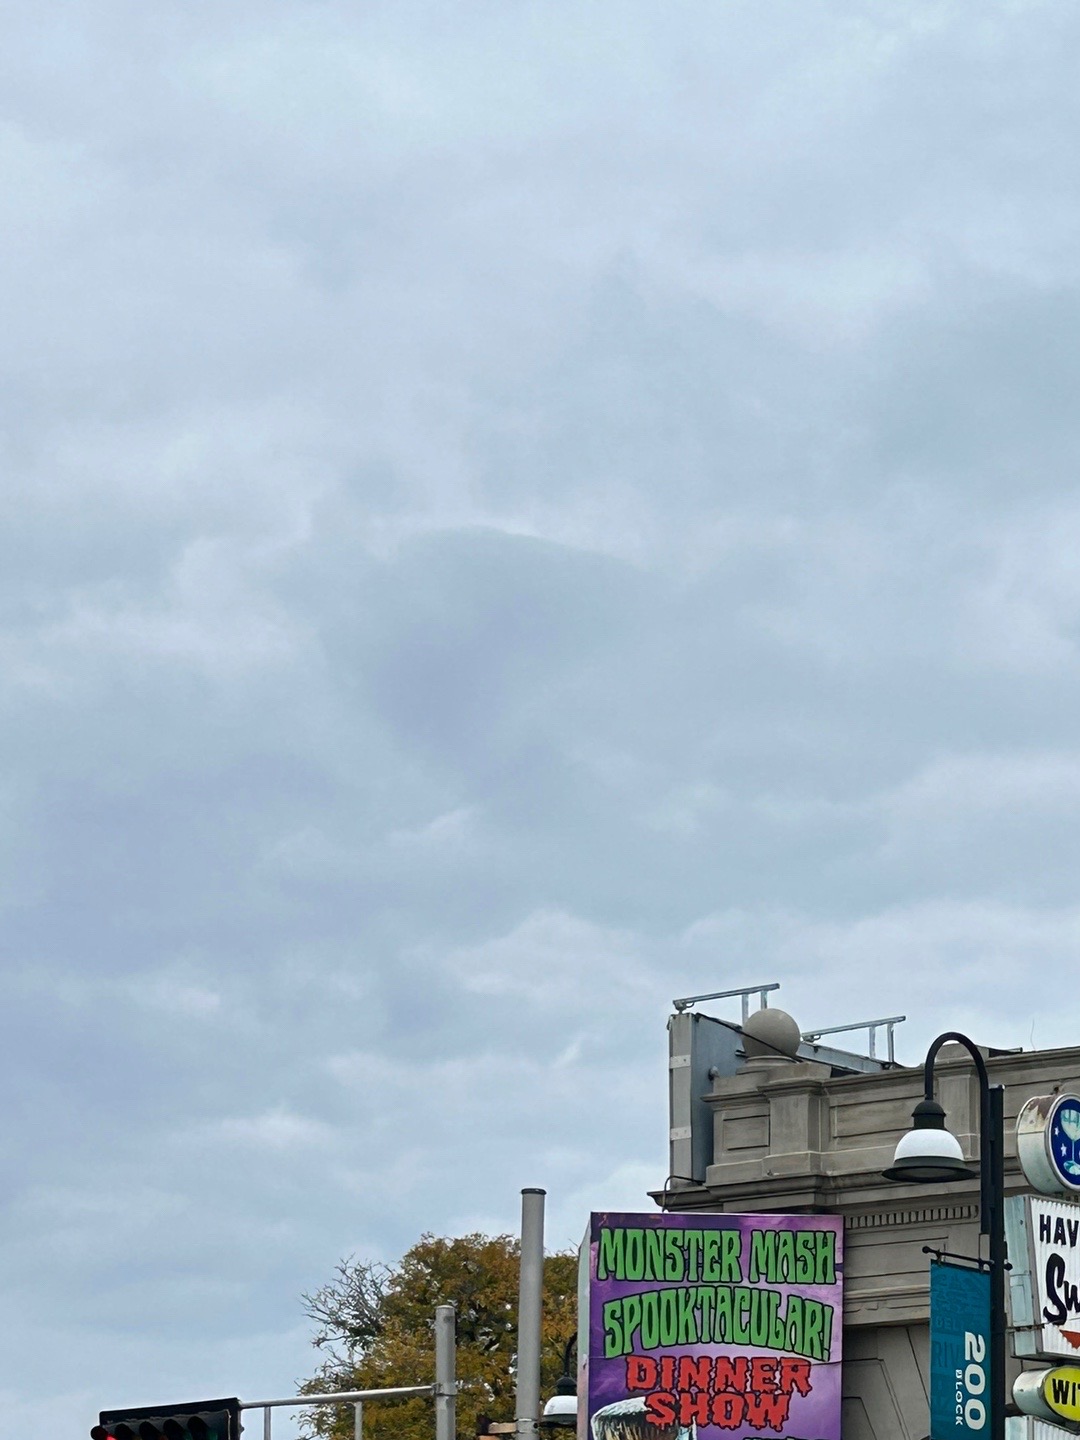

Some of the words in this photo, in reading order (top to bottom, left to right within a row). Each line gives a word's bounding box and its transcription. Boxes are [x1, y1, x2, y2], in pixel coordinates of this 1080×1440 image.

[598, 1227, 742, 1283] MONSTER
[750, 1229, 837, 1285] MASH
[603, 1285, 833, 1362] SPOOKTACULAR!
[625, 1355, 813, 1397] DINNER
[955, 1369, 964, 1426] BLOCK
[964, 1331, 987, 1431] 200
[645, 1391, 791, 1432] SHOW
